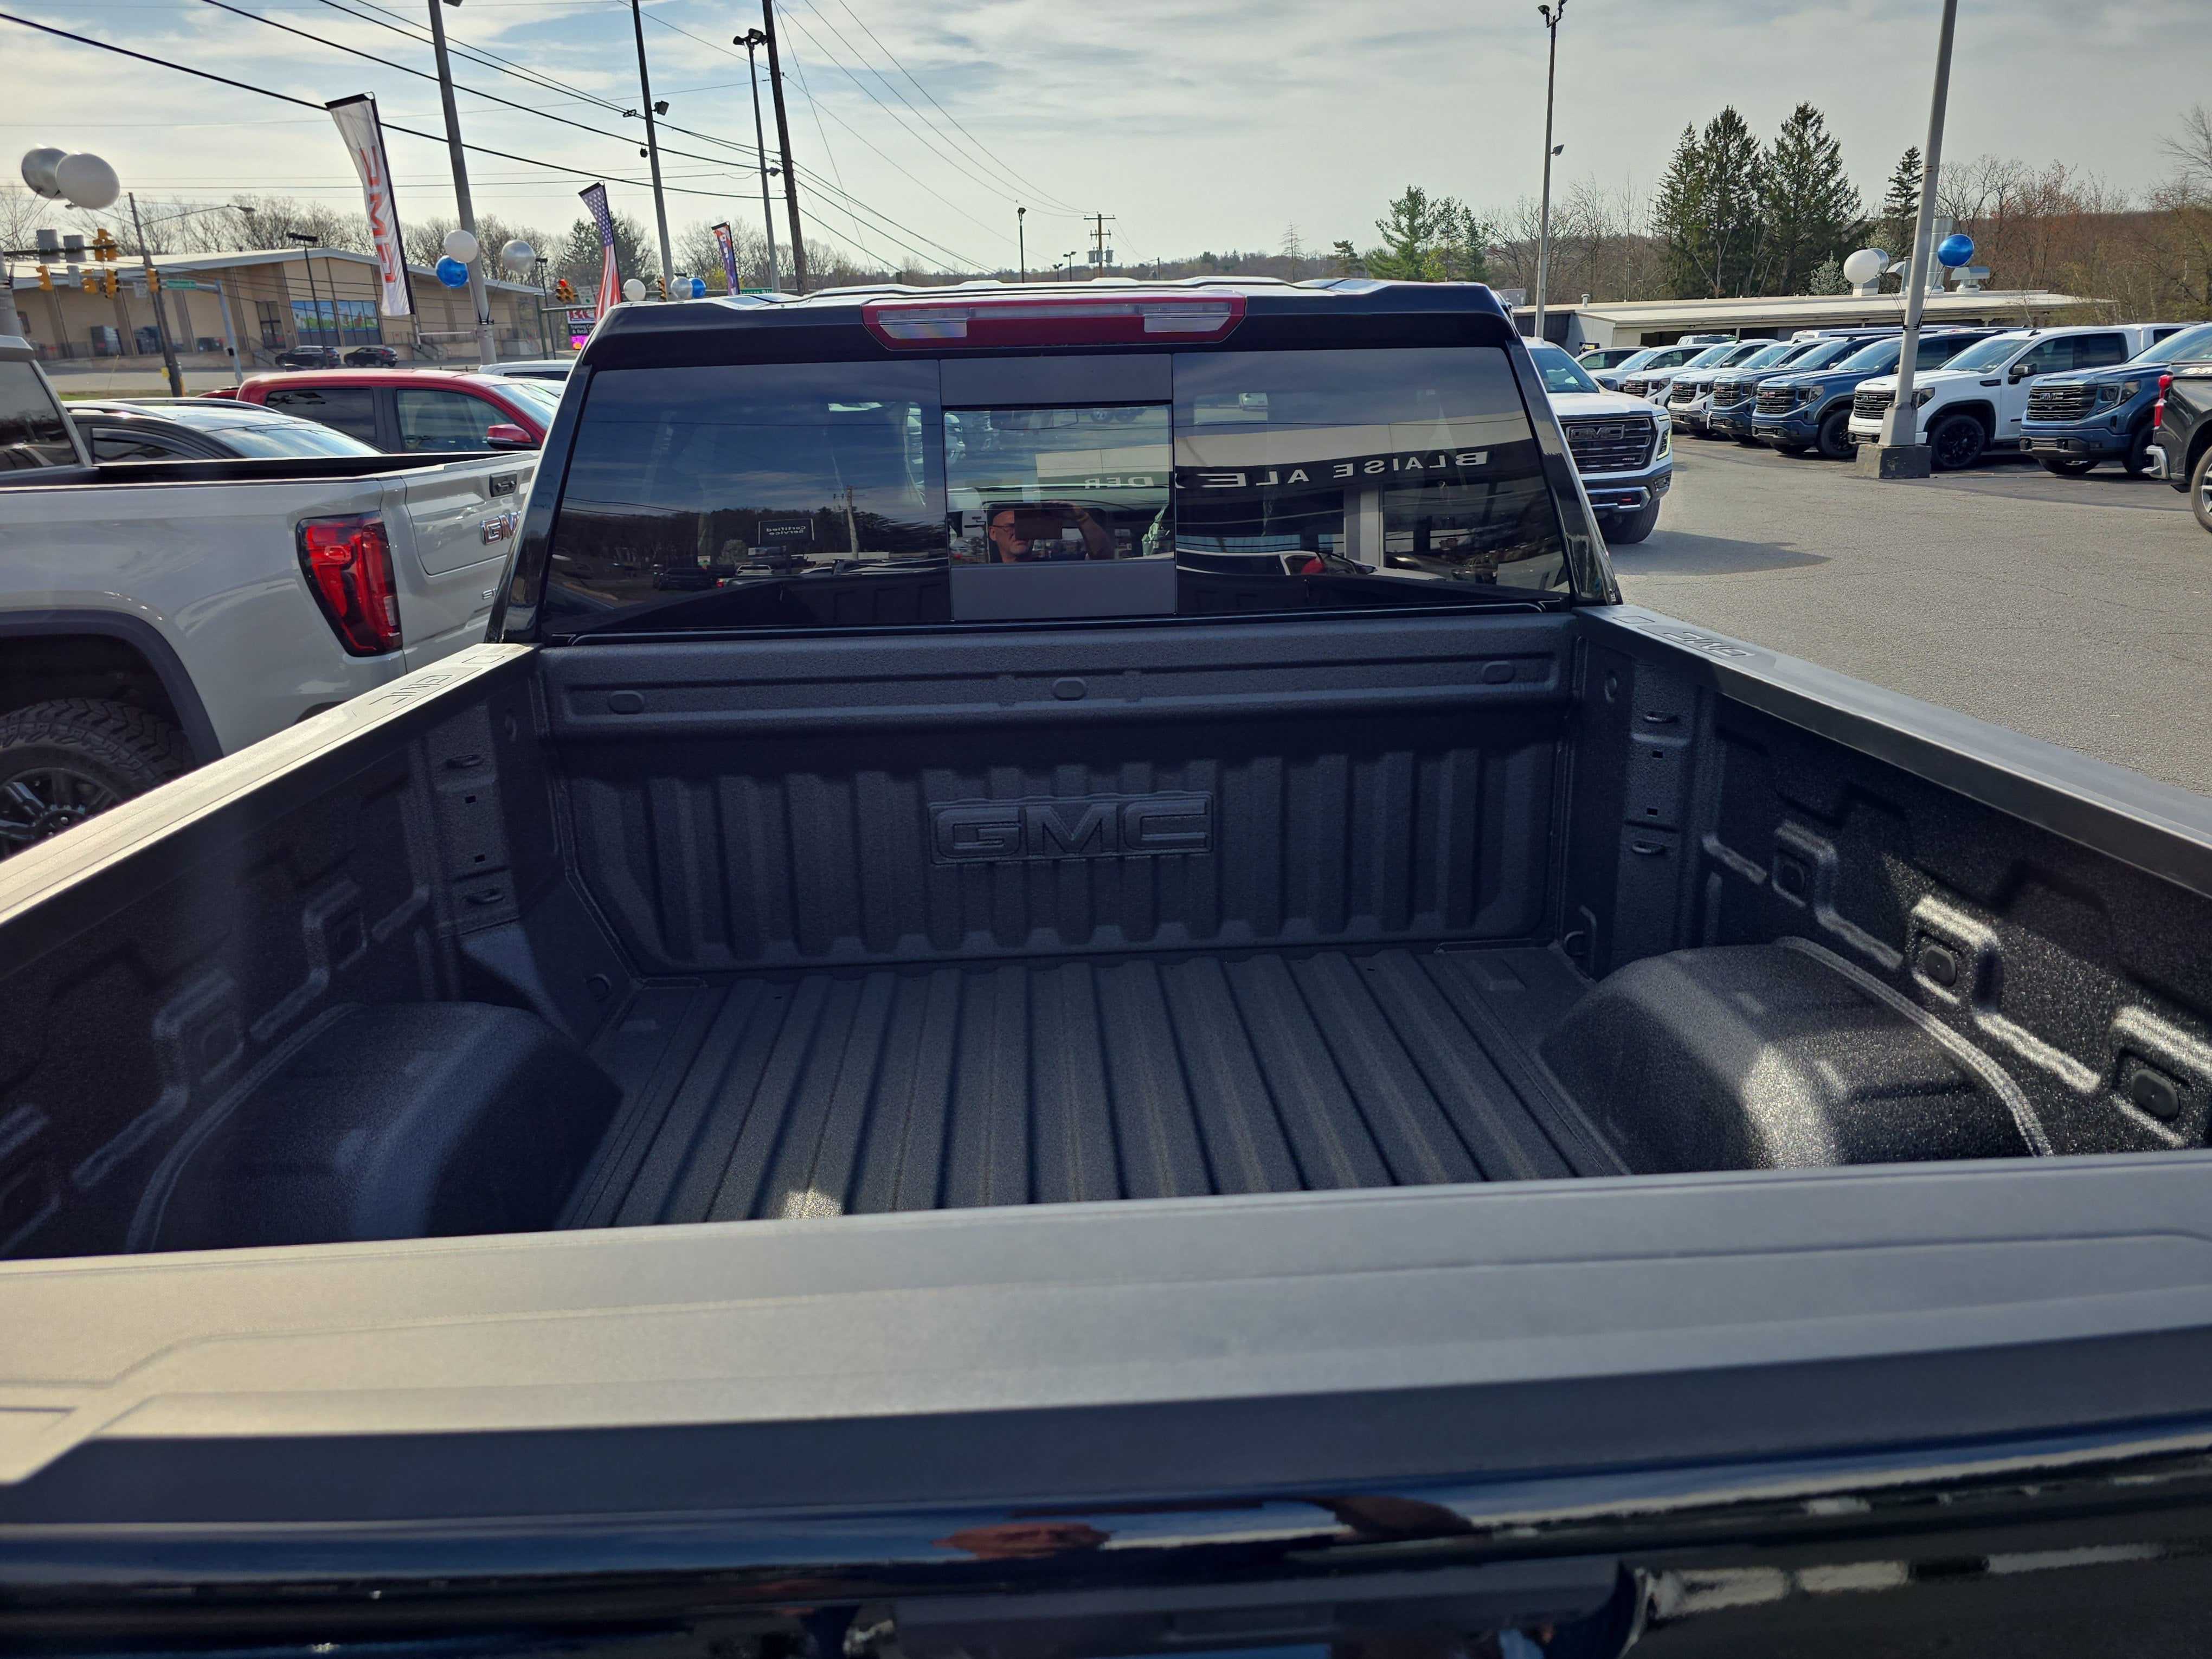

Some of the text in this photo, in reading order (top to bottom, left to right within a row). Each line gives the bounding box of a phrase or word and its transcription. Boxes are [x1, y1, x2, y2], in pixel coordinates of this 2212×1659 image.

[1571, 426, 1622, 440] GMC
[479, 511, 522, 545] GM
[936, 800, 1207, 859] GMC
